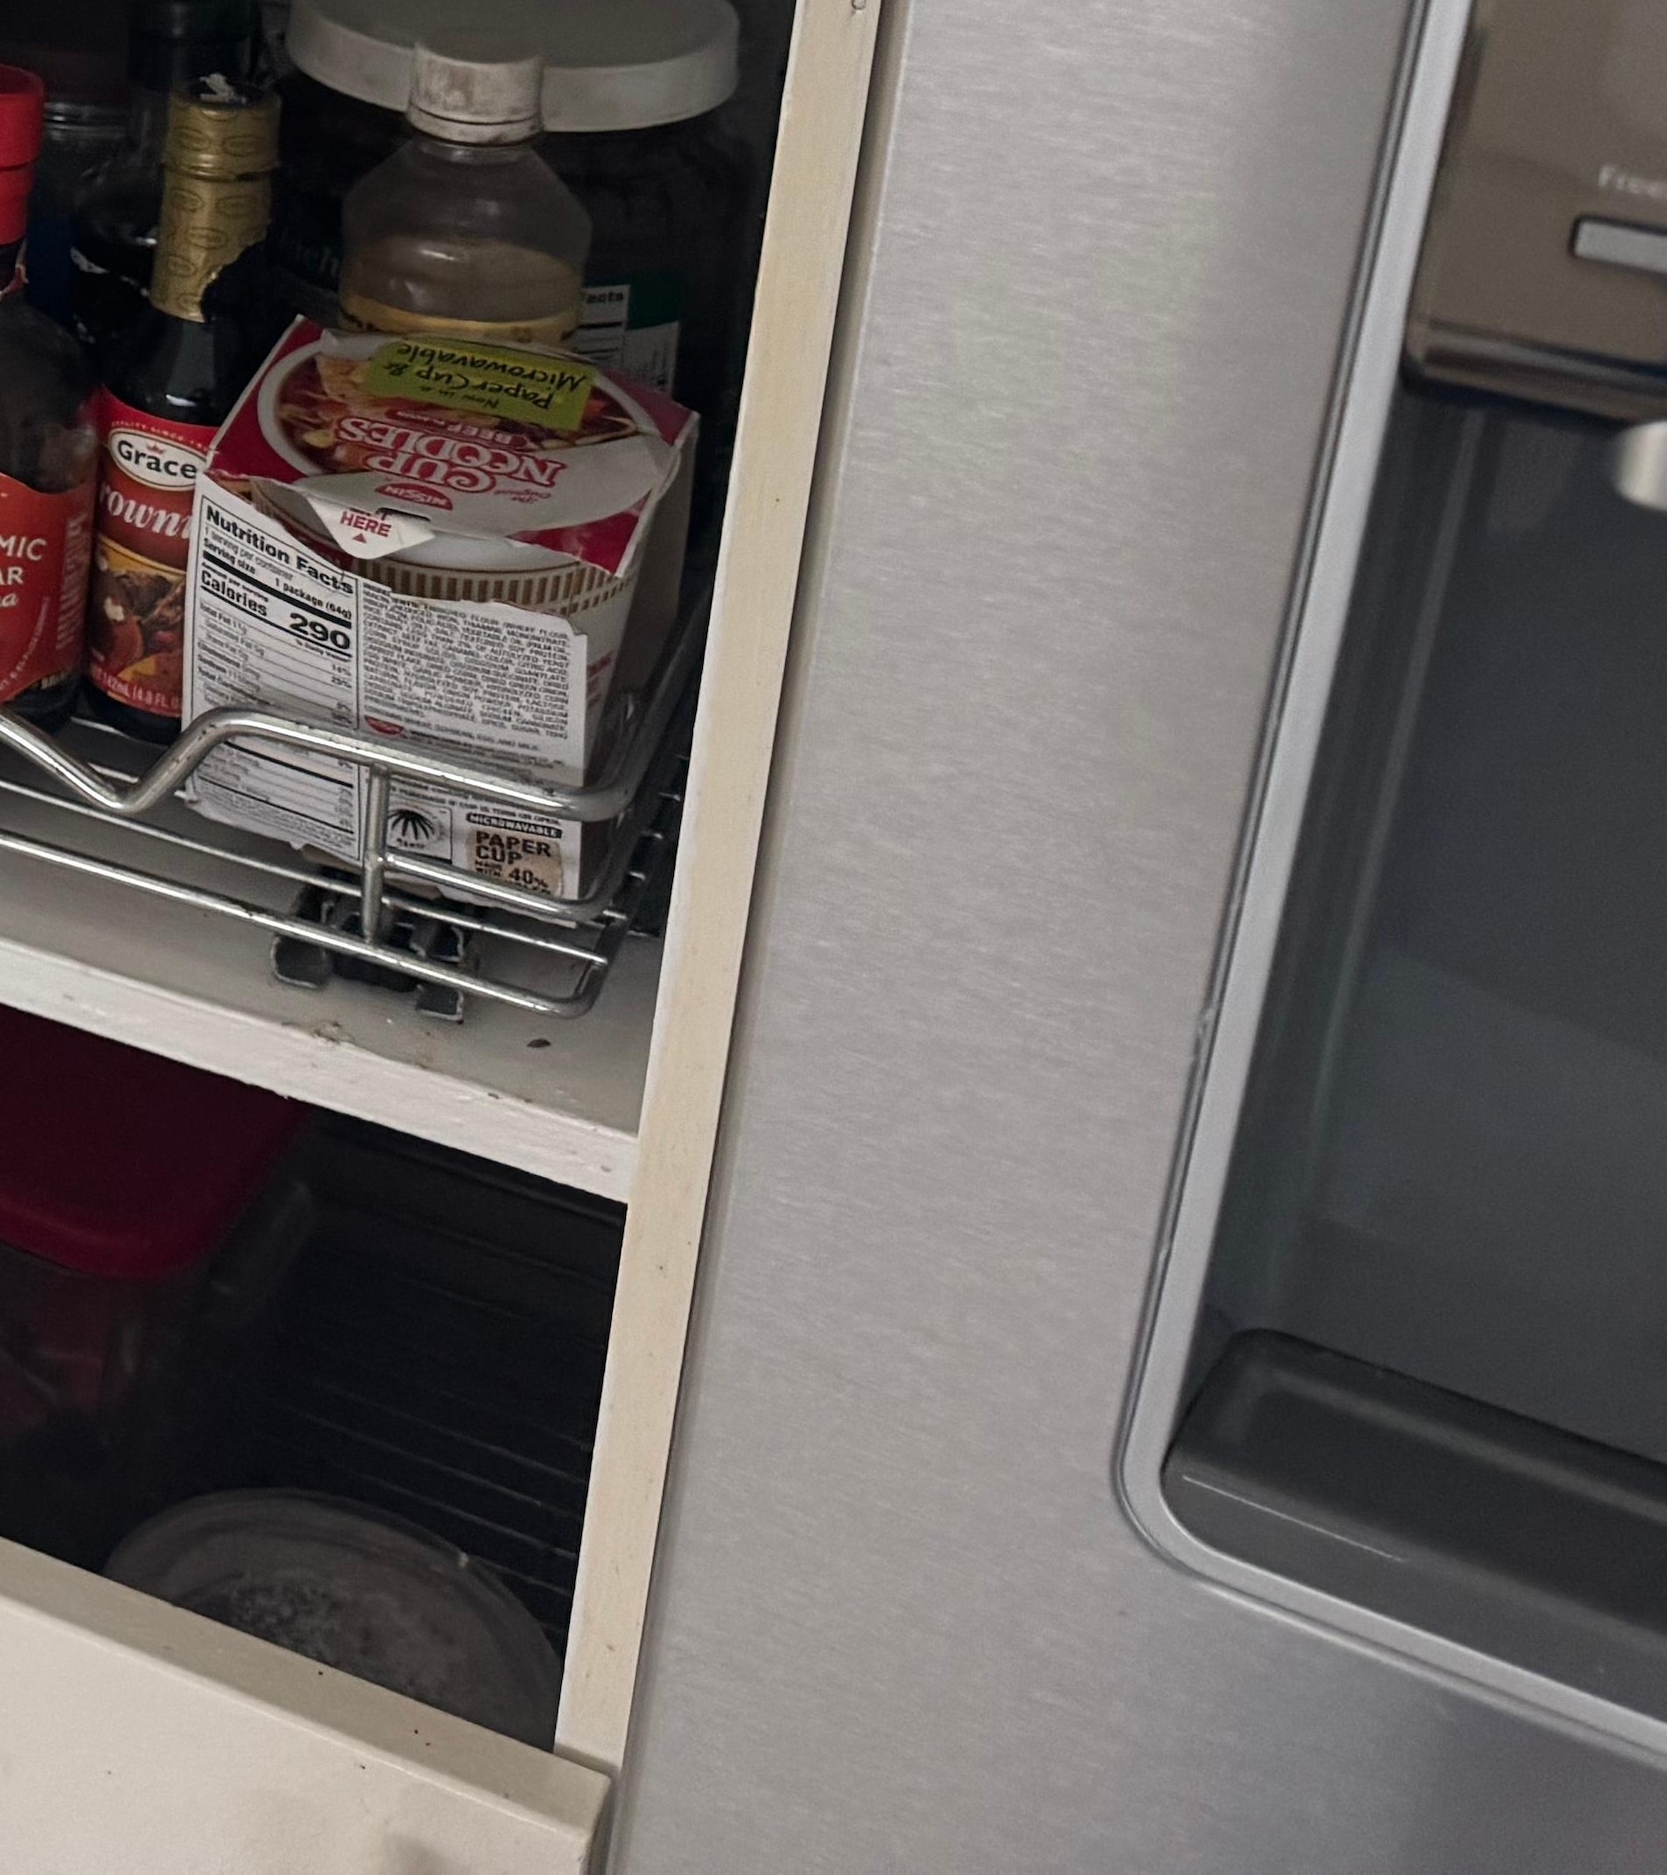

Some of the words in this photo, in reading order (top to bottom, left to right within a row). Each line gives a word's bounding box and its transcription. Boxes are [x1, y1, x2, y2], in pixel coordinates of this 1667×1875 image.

[397, 342, 587, 393] Microwavable
[417, 365, 468, 390] Cup
[475, 381, 555, 411] Paper
[117, 440, 196, 479] Grace
[338, 417, 563, 487] NOODLES
[365, 452, 495, 493] CUP
[385, 486, 447, 506] NISSIN
[340, 510, 392, 538] HERE
[206, 505, 291, 565] Nutrition
[295, 555, 355, 596] Facts
[201, 569, 269, 617] Calories
[289, 612, 353, 651] 290
[468, 813, 560, 838] MICROWAVABLE
[475, 830, 552, 857] PAPER
[475, 845, 523, 865] CUP
[508, 868, 549, 888] 40%
